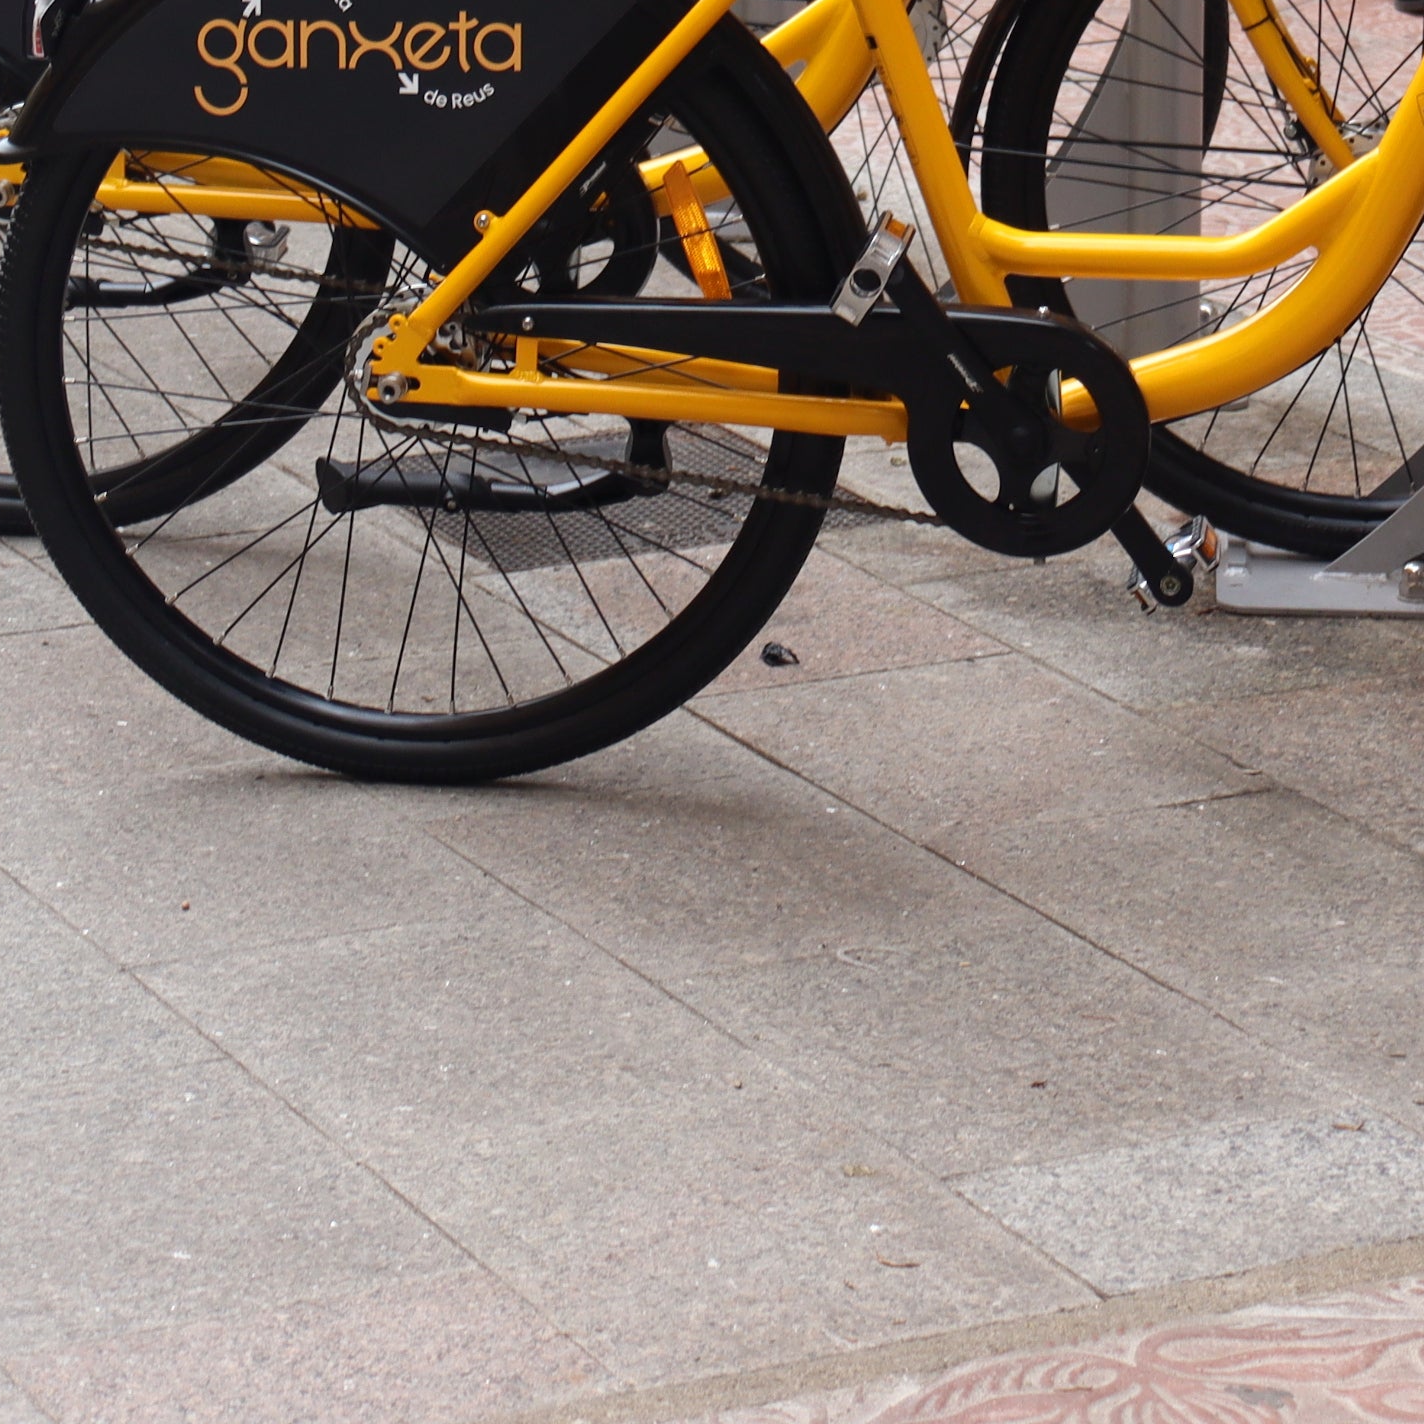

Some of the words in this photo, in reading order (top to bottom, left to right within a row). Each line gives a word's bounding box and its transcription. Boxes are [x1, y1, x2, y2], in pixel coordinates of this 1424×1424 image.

[193, 9, 523, 117] ganxeta
[424, 87, 448, 108] de
[451, 81, 496, 110] Reus
